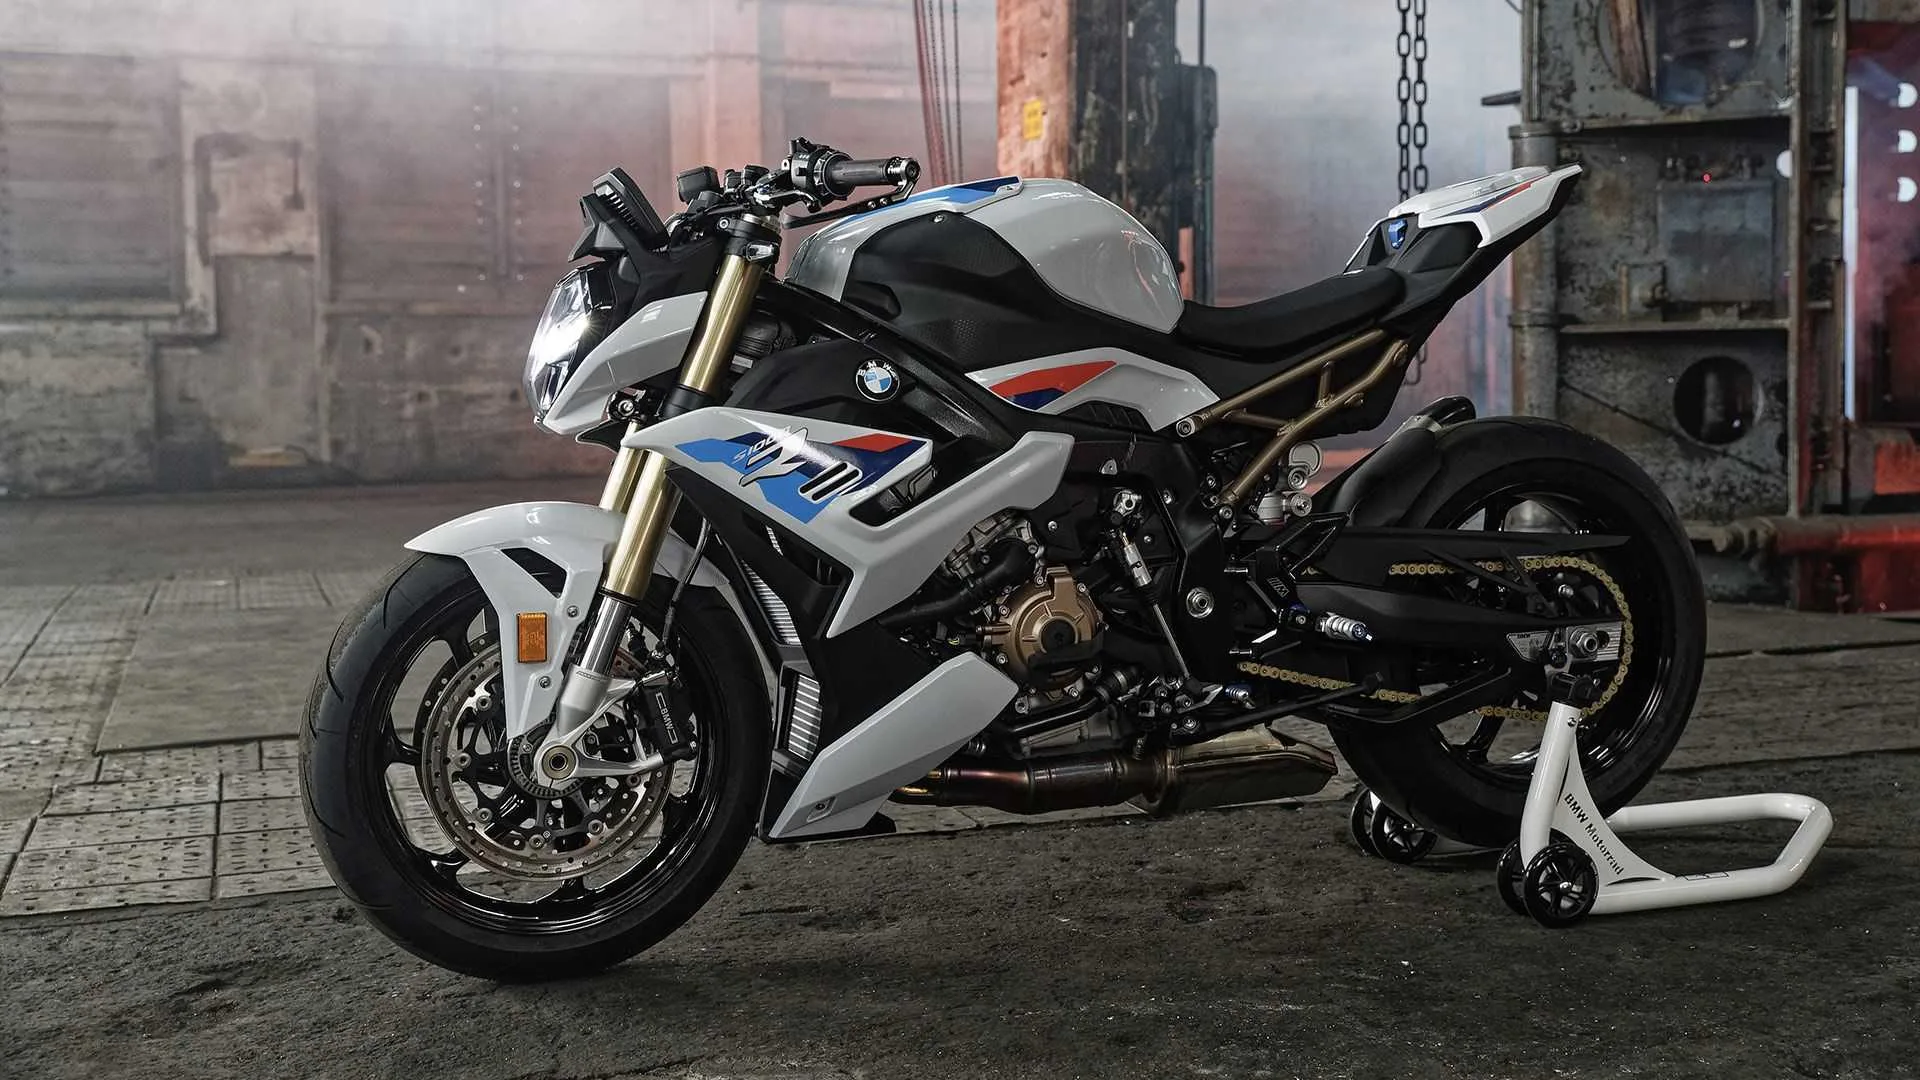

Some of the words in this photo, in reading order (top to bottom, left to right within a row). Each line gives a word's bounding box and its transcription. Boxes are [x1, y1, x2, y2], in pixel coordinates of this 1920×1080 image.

[858, 360, 892, 377] BMW
[660, 707, 674, 730] BMW
[1564, 793, 1588, 823] BMW
[1585, 823, 1624, 875] Motorrad
